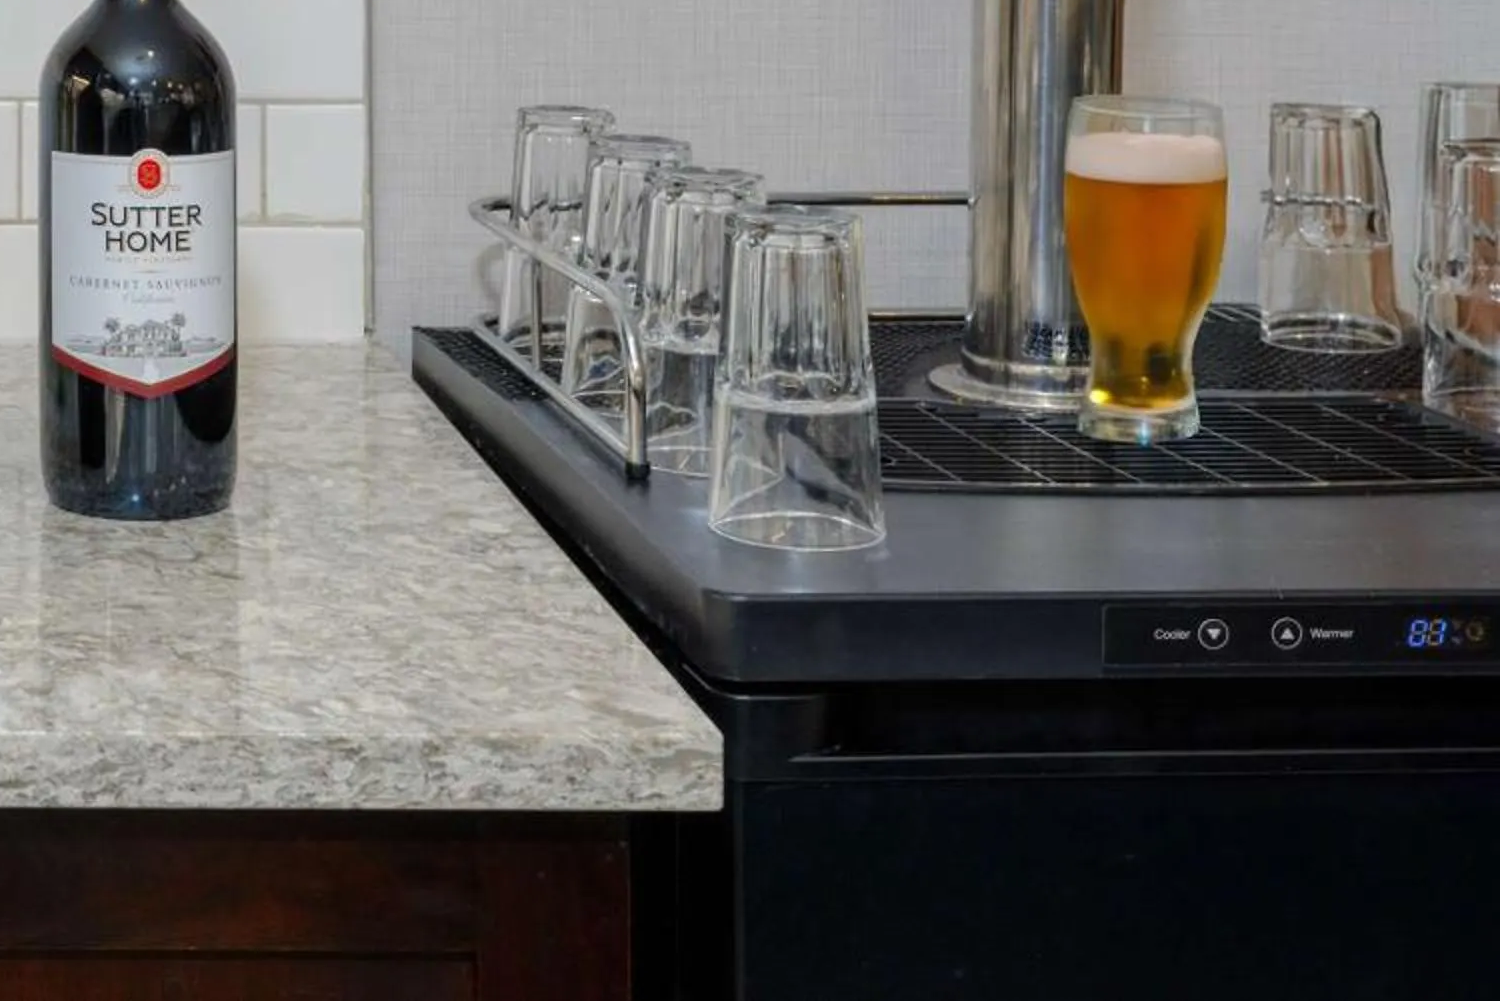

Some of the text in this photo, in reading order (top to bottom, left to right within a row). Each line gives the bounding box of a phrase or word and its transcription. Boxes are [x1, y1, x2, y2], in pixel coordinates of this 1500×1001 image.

[90, 202, 202, 227] SUTTER
[105, 230, 192, 252] HOME
[1154, 628, 1191, 641] Cooler
[1310, 627, 1354, 639] Warmer
